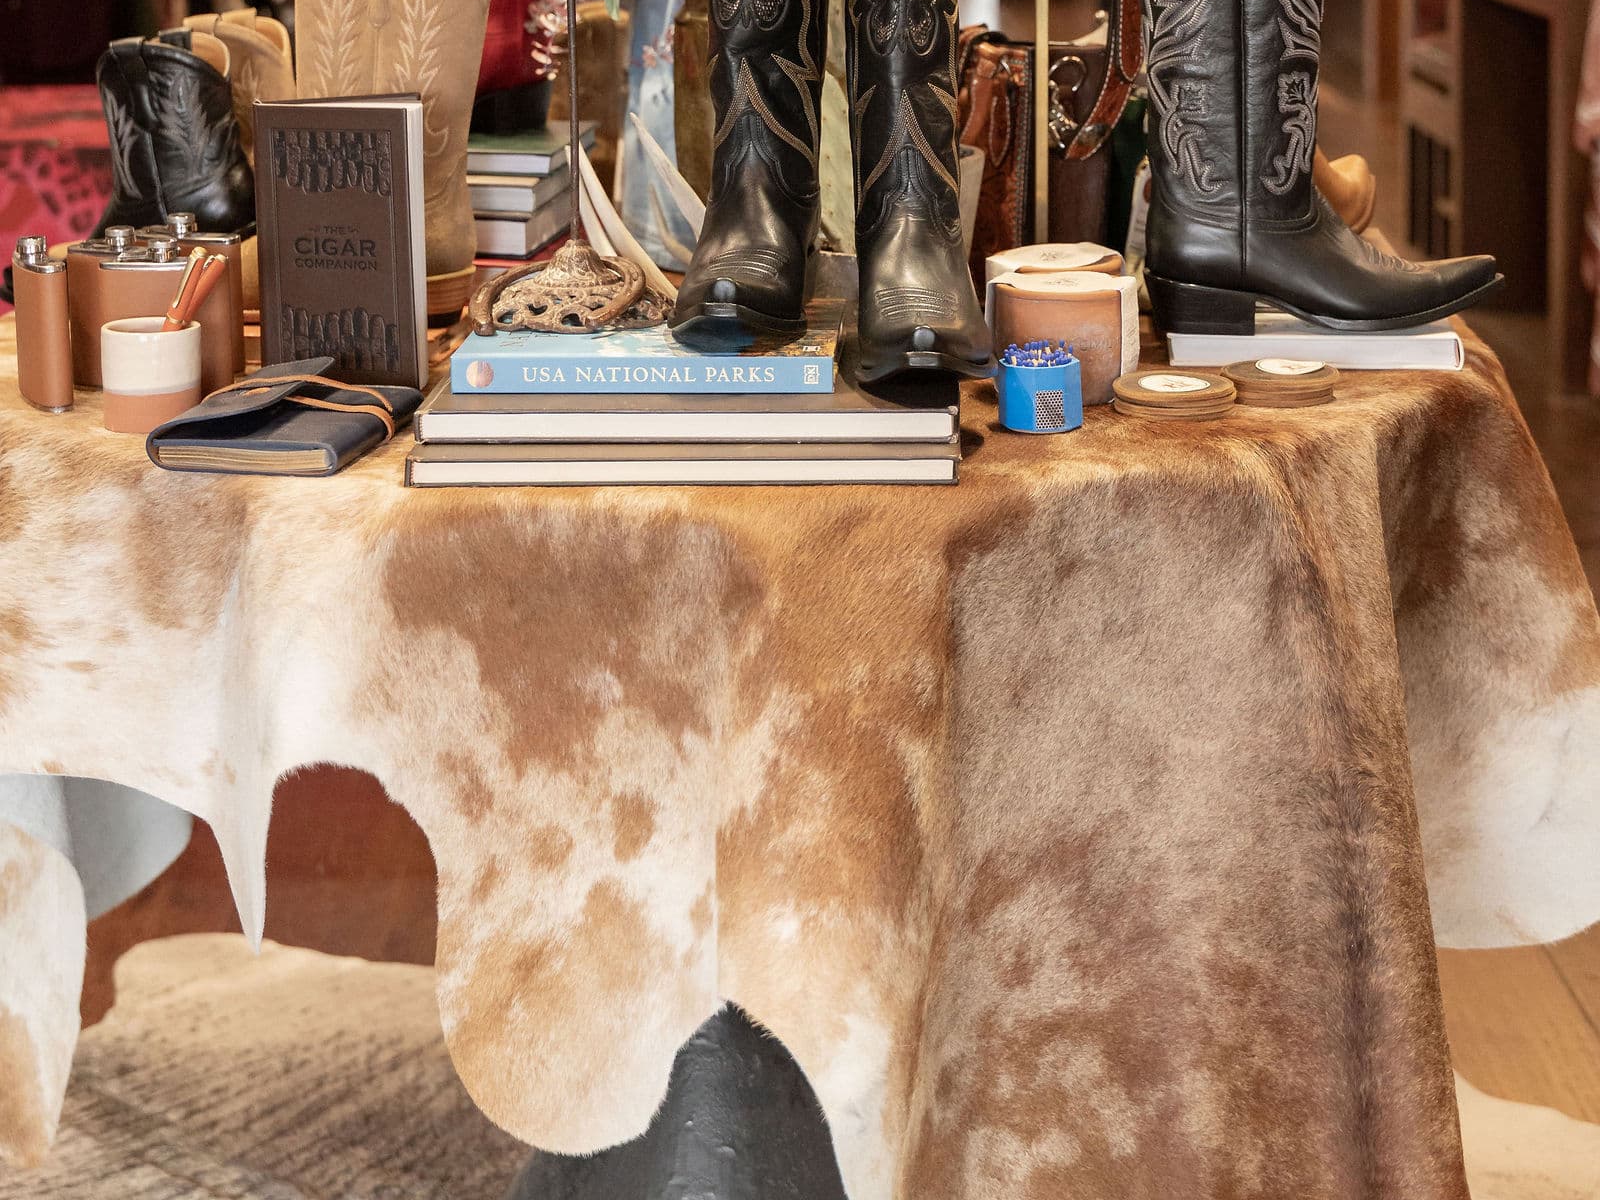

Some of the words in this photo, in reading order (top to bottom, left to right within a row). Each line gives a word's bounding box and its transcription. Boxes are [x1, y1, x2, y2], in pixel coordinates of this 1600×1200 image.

[323, 225, 347, 235] THE
[294, 237, 377, 257] CIGAR
[295, 257, 378, 271] COMPANION
[522, 366, 567, 383] USA
[575, 366, 697, 383] NATIONAL
[704, 366, 775, 383] PARKS
[806, 366, 818, 383] DK
